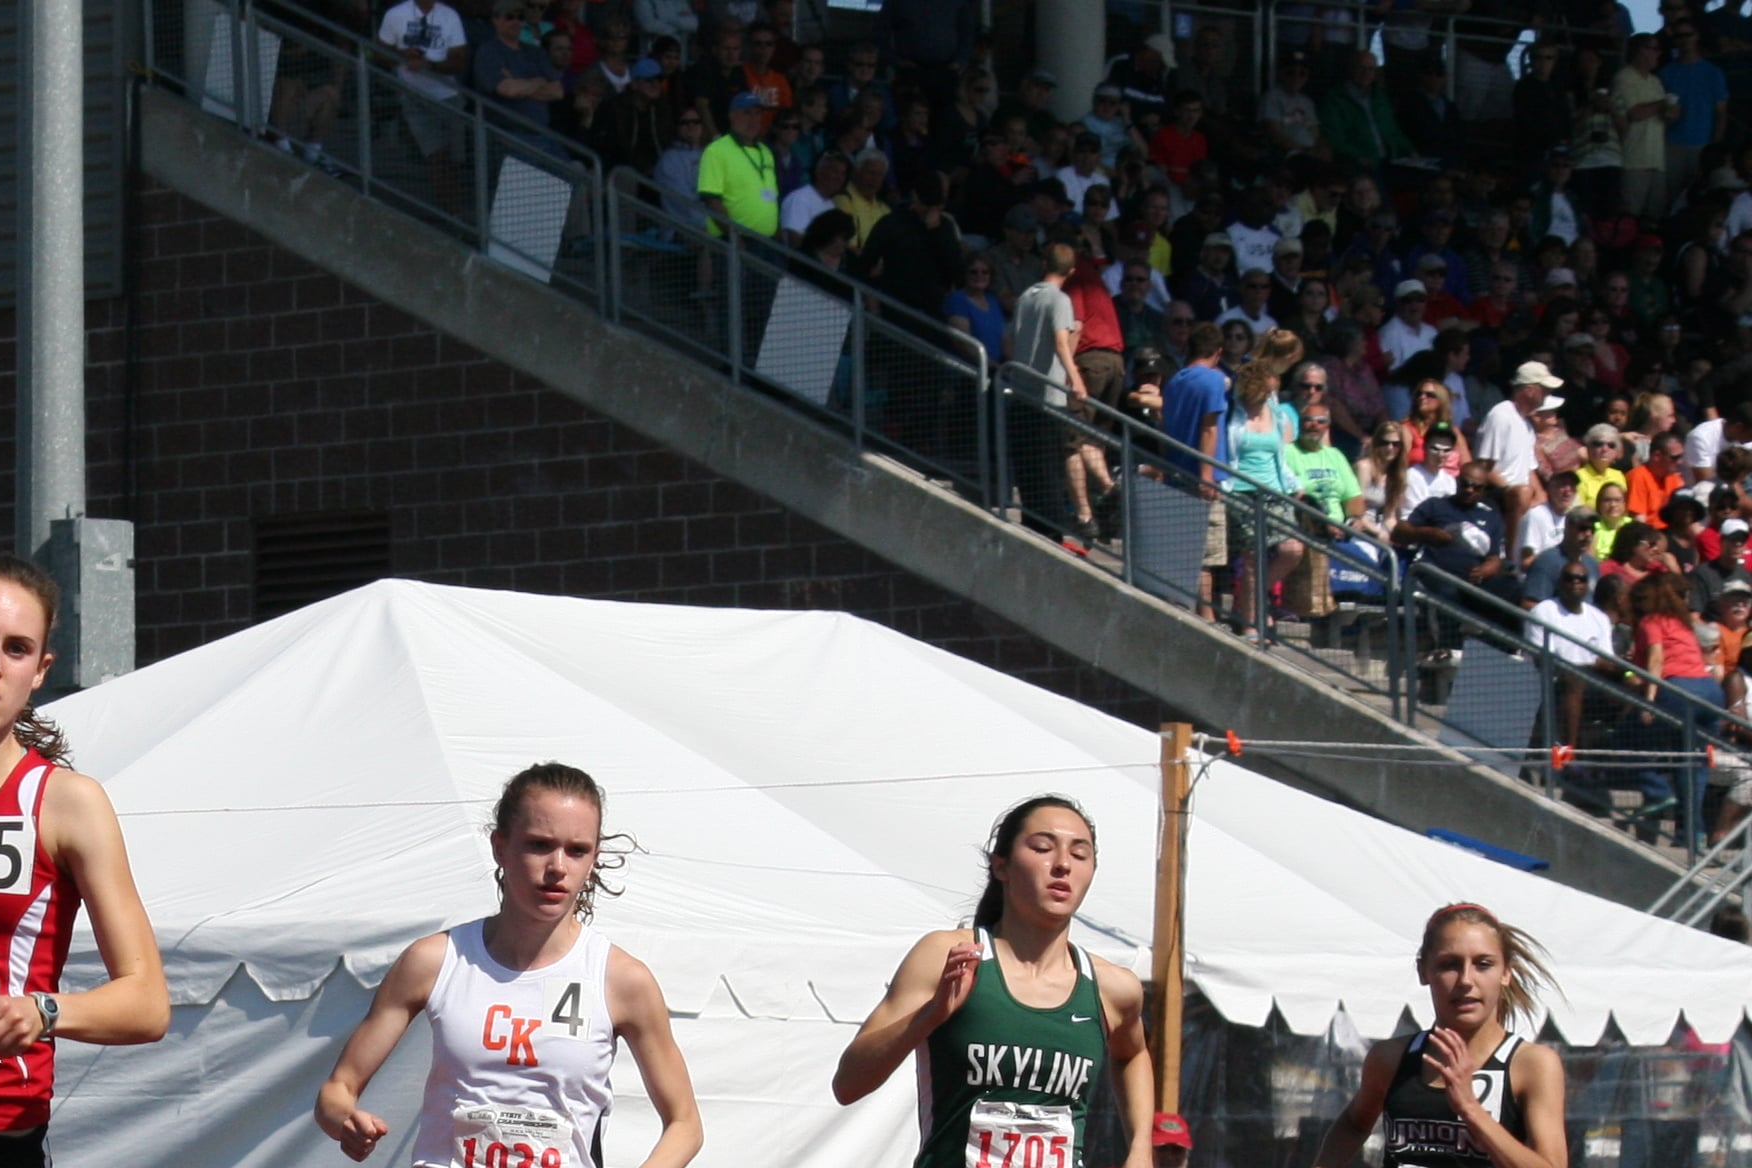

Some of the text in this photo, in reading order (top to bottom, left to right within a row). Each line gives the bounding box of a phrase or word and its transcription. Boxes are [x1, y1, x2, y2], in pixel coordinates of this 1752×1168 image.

[482, 1004, 542, 1066] CK
[551, 982, 584, 1037] 4
[966, 1043, 1094, 1100] SKYLINE
